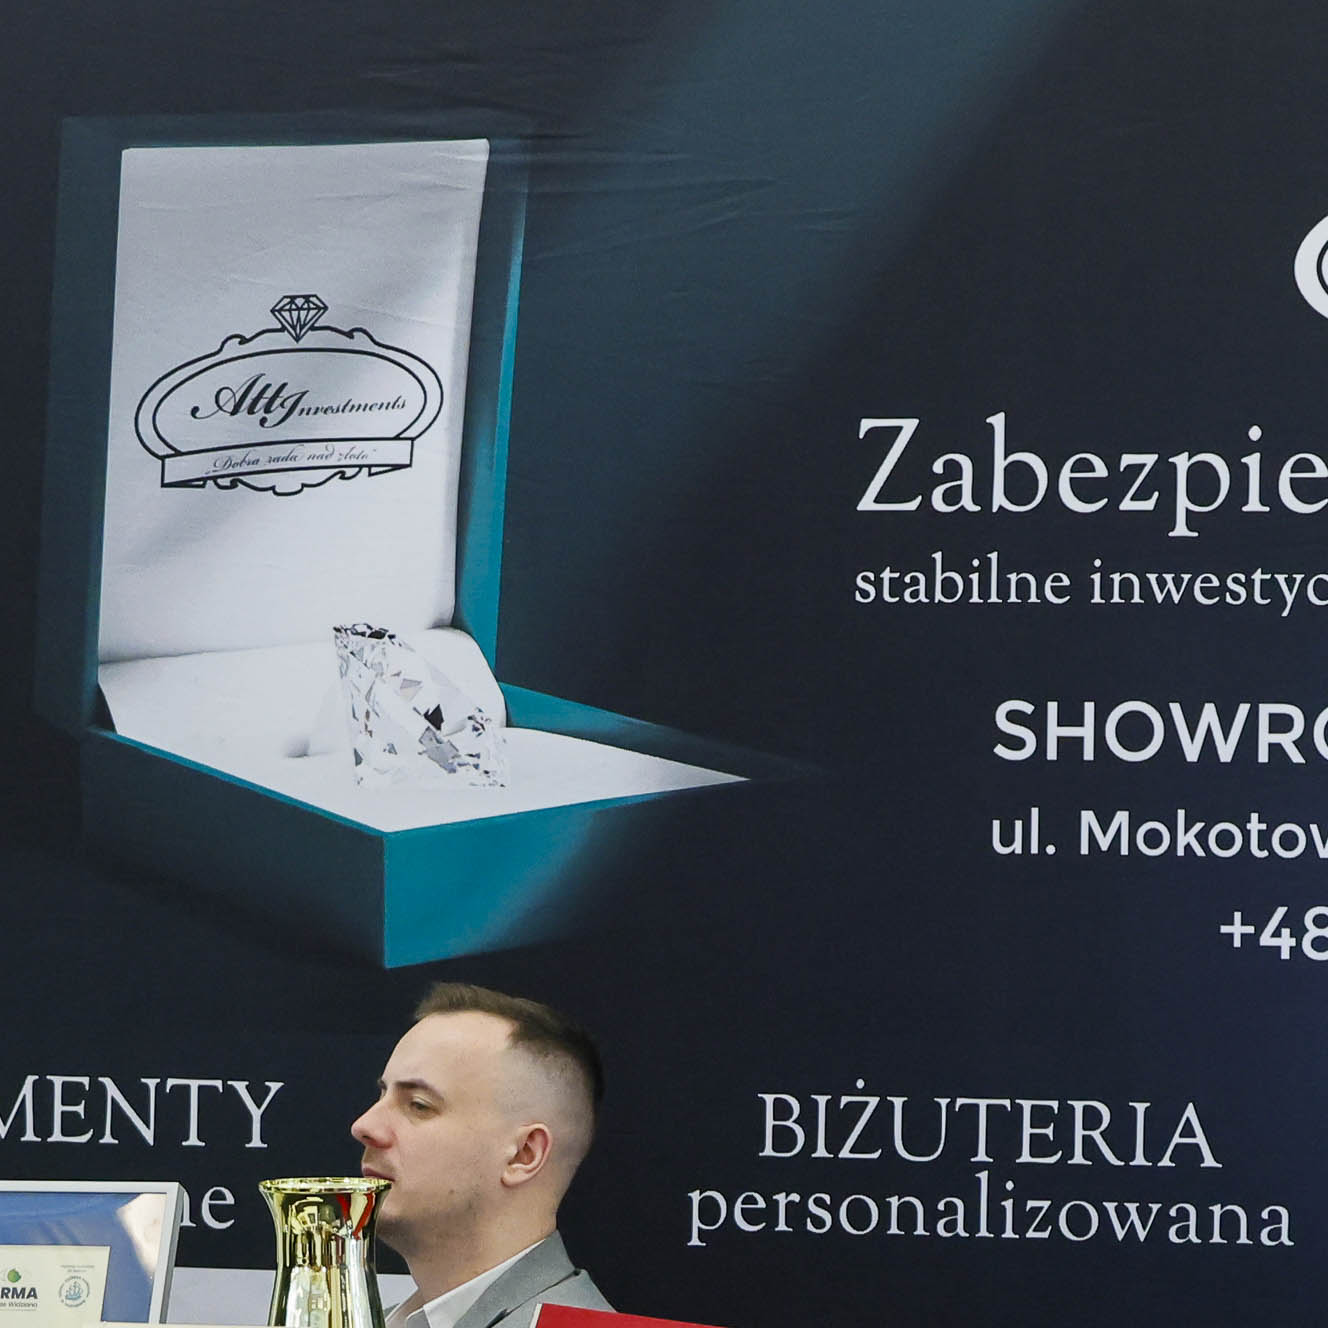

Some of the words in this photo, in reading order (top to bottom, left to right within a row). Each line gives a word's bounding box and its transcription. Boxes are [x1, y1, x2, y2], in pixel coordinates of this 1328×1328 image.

[855, 550, 1072, 605] stabilne
[991, 807, 1057, 856] ul.
[757, 1078, 1223, 1168] BIŻUTERIA
[687, 1170, 1294, 1247] personalizowana
